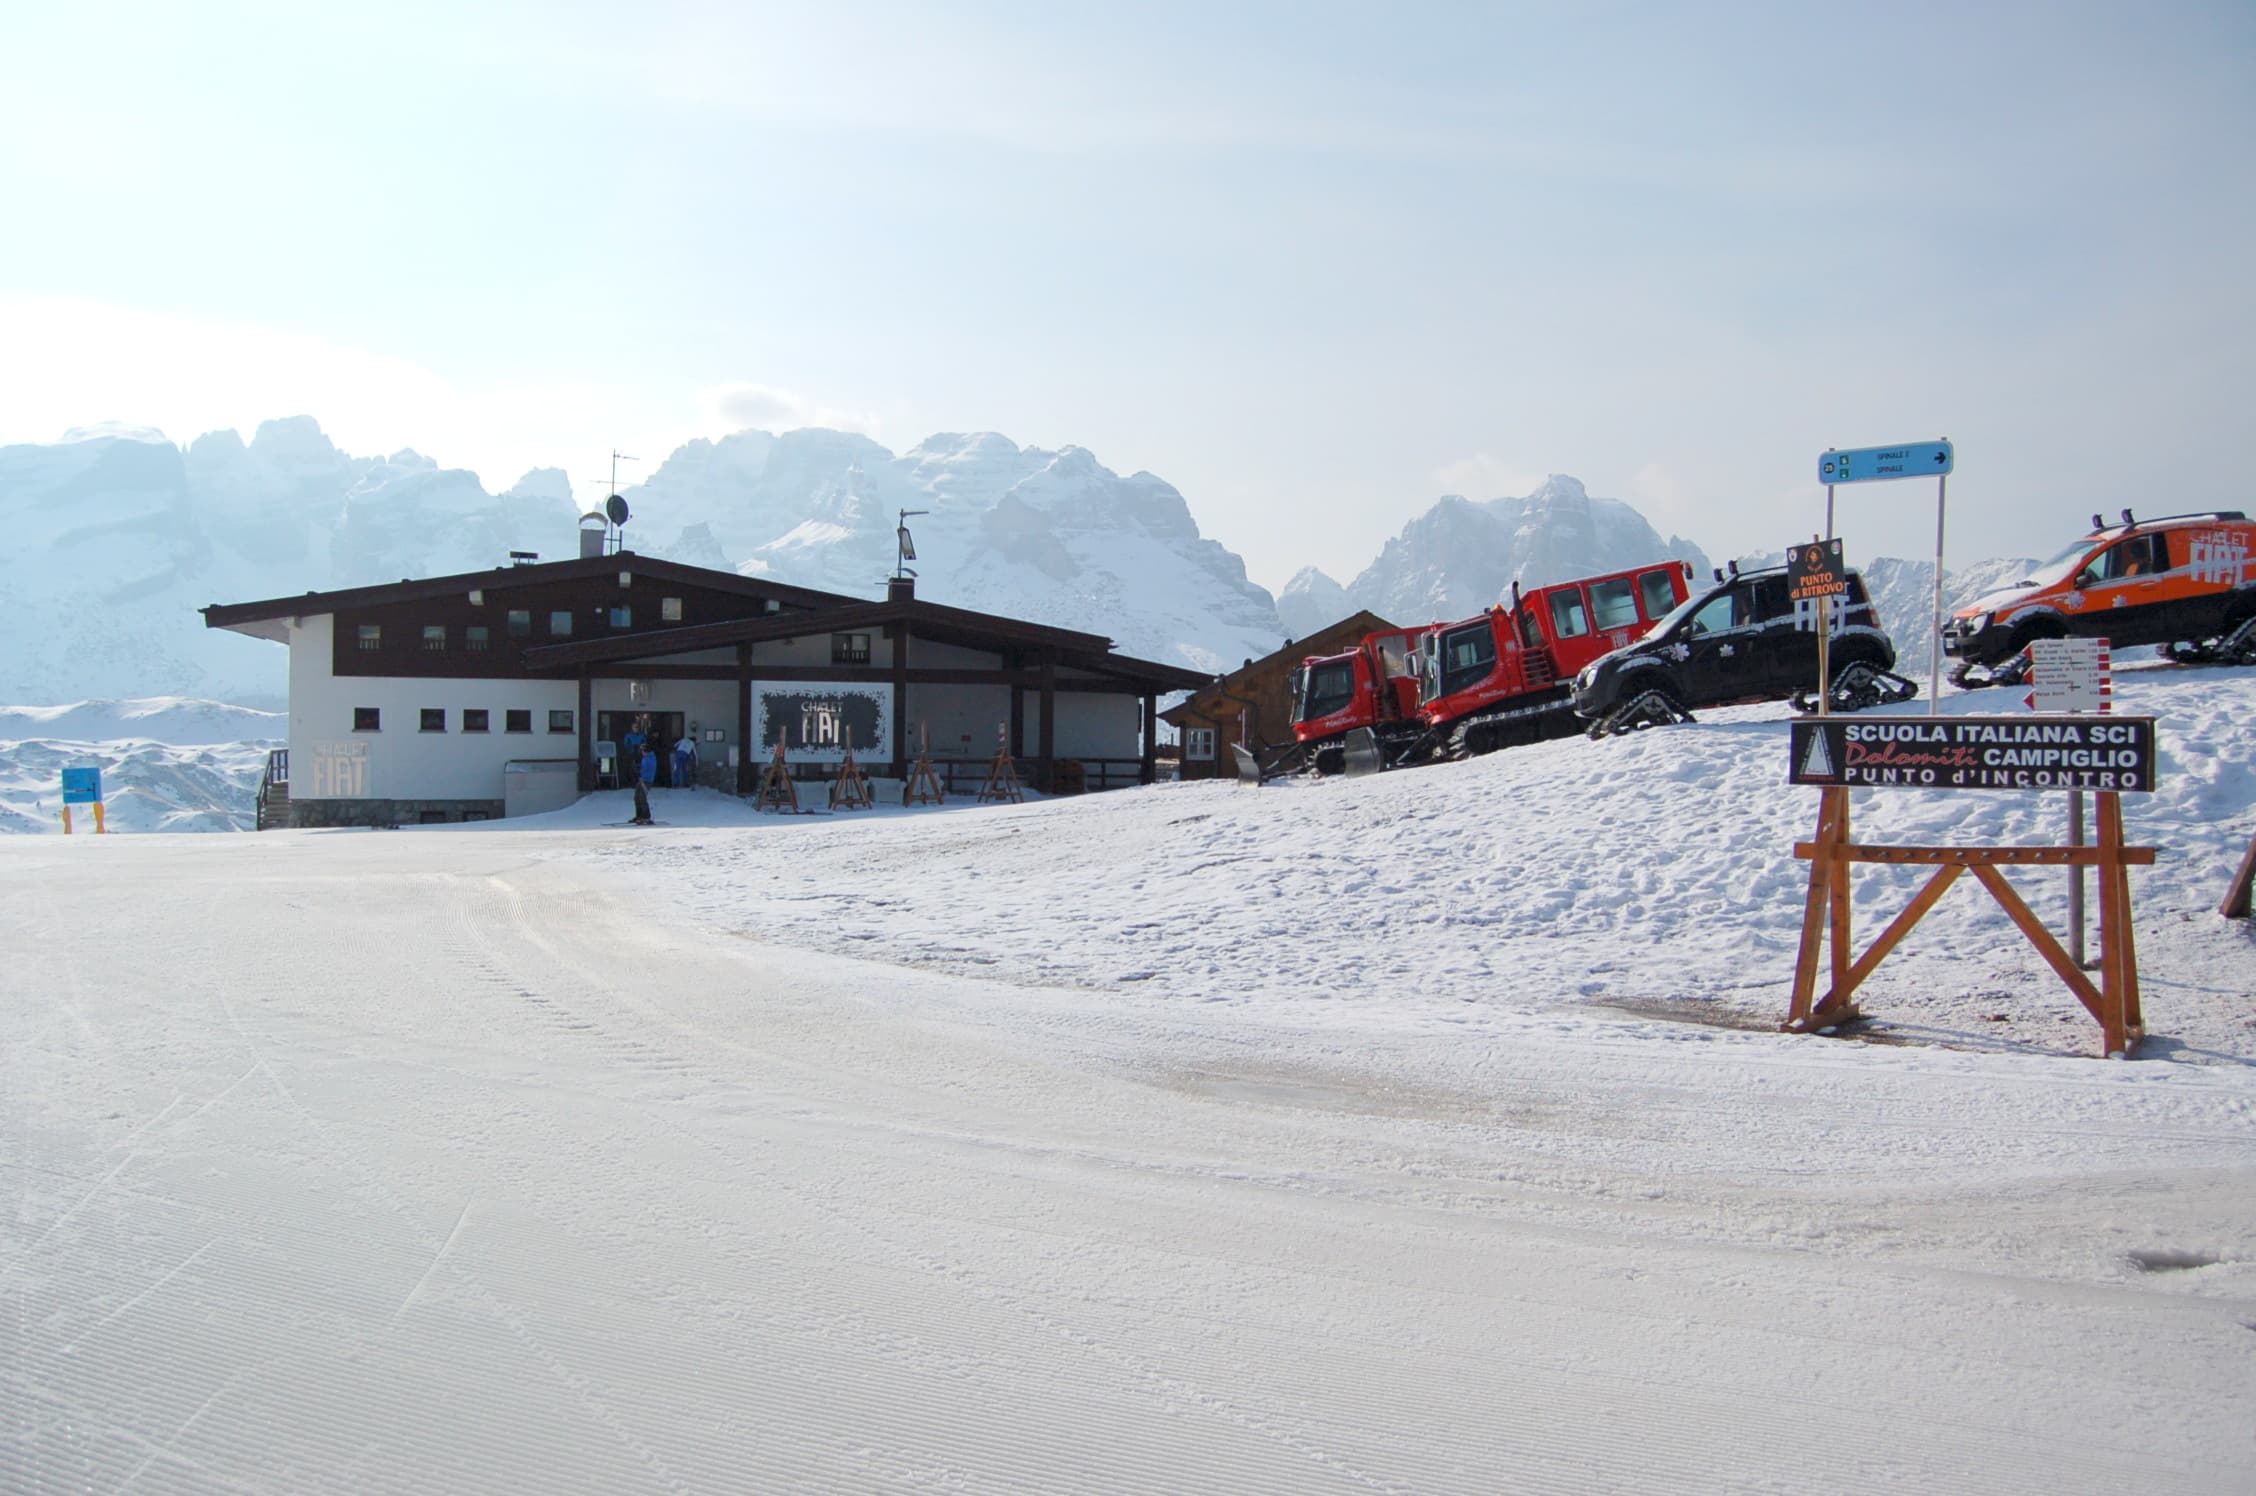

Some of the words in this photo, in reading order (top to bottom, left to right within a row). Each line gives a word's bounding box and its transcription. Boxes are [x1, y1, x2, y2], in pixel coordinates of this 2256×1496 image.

[1800, 571, 1833, 587] PUNTO
[1791, 588, 1800, 599] di
[1802, 581, 1844, 598] RITROVO
[801, 701, 842, 713] CHALET
[1844, 724, 1948, 742] SCUOLA
[1955, 725, 2082, 743] ITALIANA
[2089, 726, 2136, 744] SCI
[1845, 741, 1978, 767] Dolomiti
[1983, 748, 2138, 768] CAMPIGLIO
[313, 756, 367, 796] FIAT
[1844, 767, 1936, 783] PUNTO
[1952, 769, 2138, 788] d'INCONTRO
